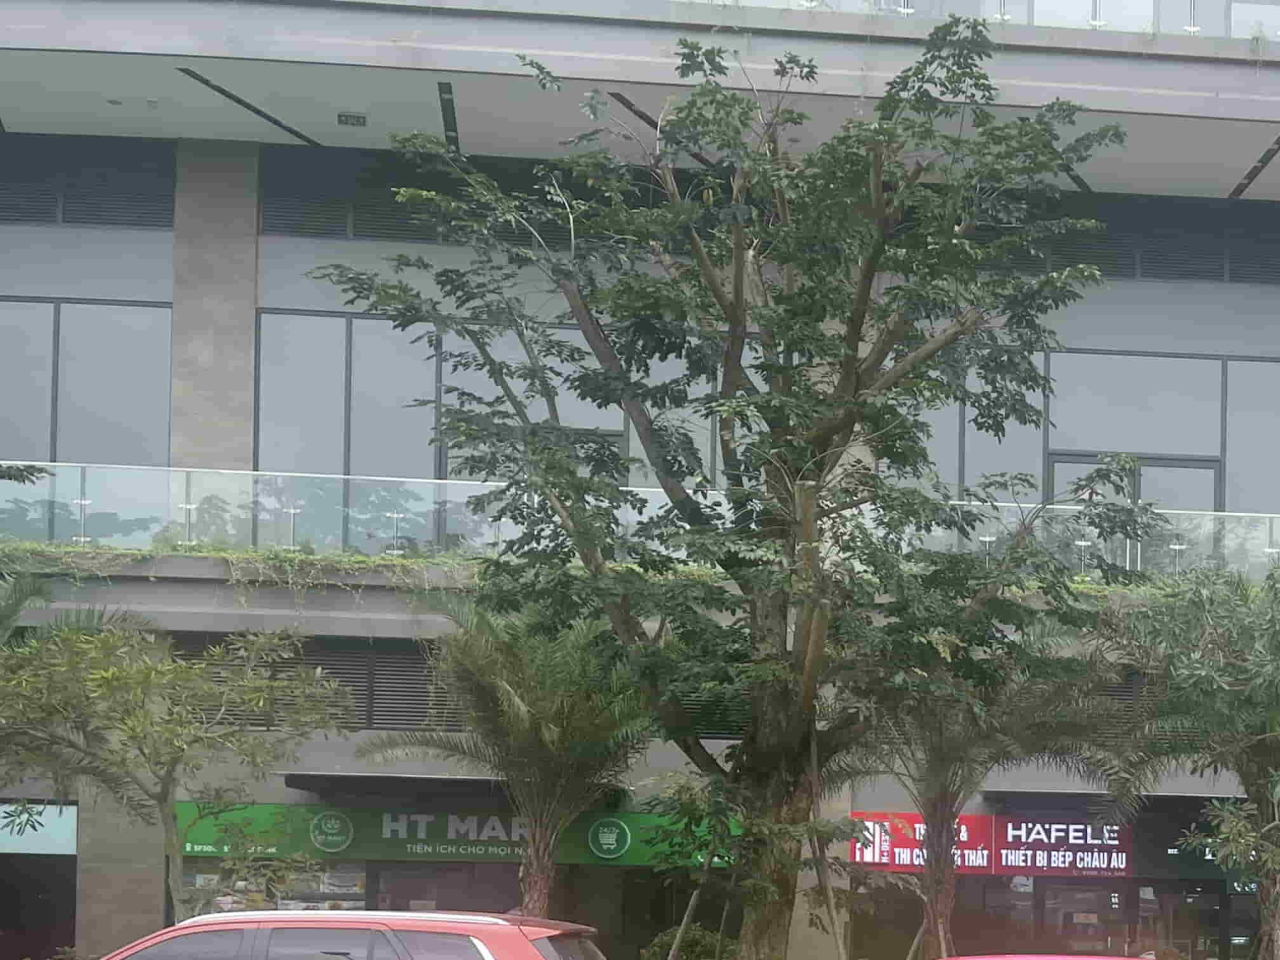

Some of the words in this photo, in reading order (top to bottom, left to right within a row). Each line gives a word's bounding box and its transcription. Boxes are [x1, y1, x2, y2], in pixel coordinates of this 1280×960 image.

[382, 813, 435, 839] HT
[447, 814, 530, 842] MAR
[459, 845, 484, 854] CHO
[894, 848, 910, 865] THI
[1000, 845, 1033, 867] THIẾT
[1035, 850, 1048, 870] BỊ
[1050, 845, 1074, 868] BẾP
[1076, 848, 1108, 868] CHÂU
[1110, 849, 1127, 869] ÂU
